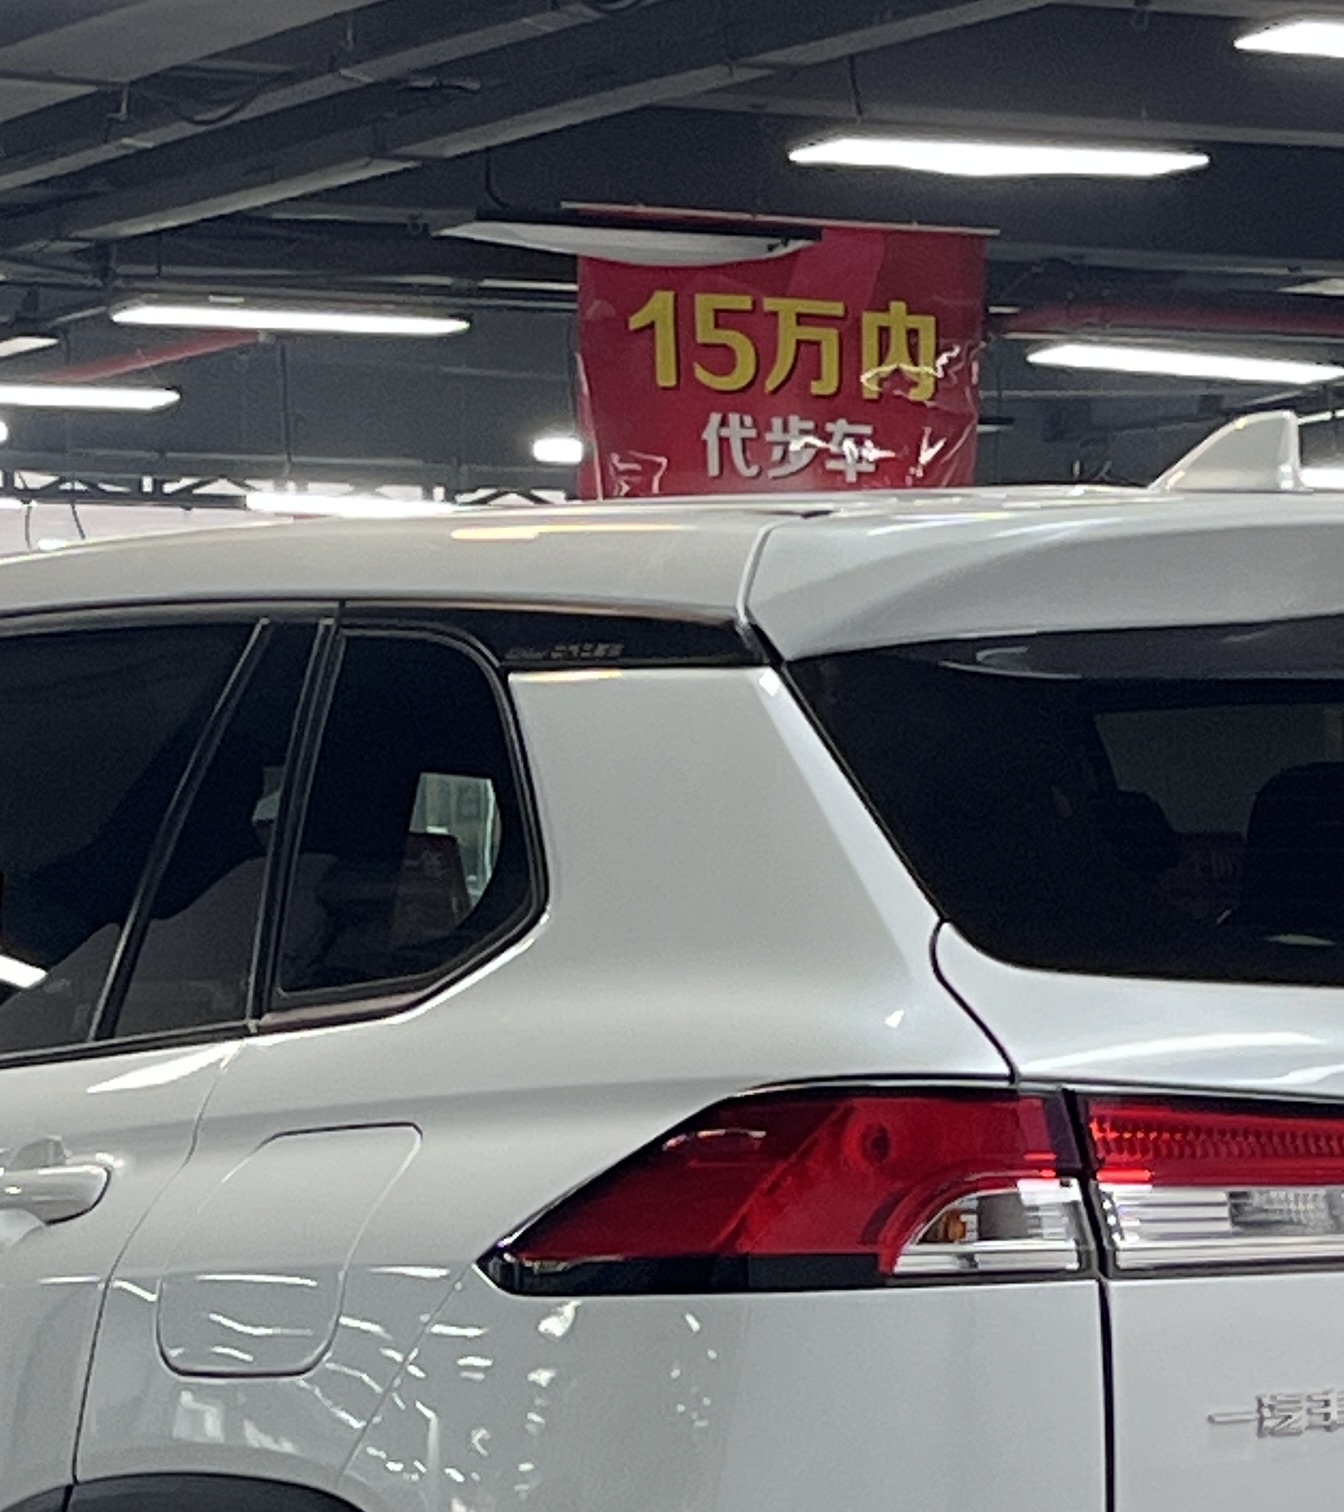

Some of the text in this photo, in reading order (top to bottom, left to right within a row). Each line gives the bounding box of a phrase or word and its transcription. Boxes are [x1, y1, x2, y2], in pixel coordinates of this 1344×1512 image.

[626, 288, 940, 403] 15万内
[700, 411, 879, 484] 代步车
